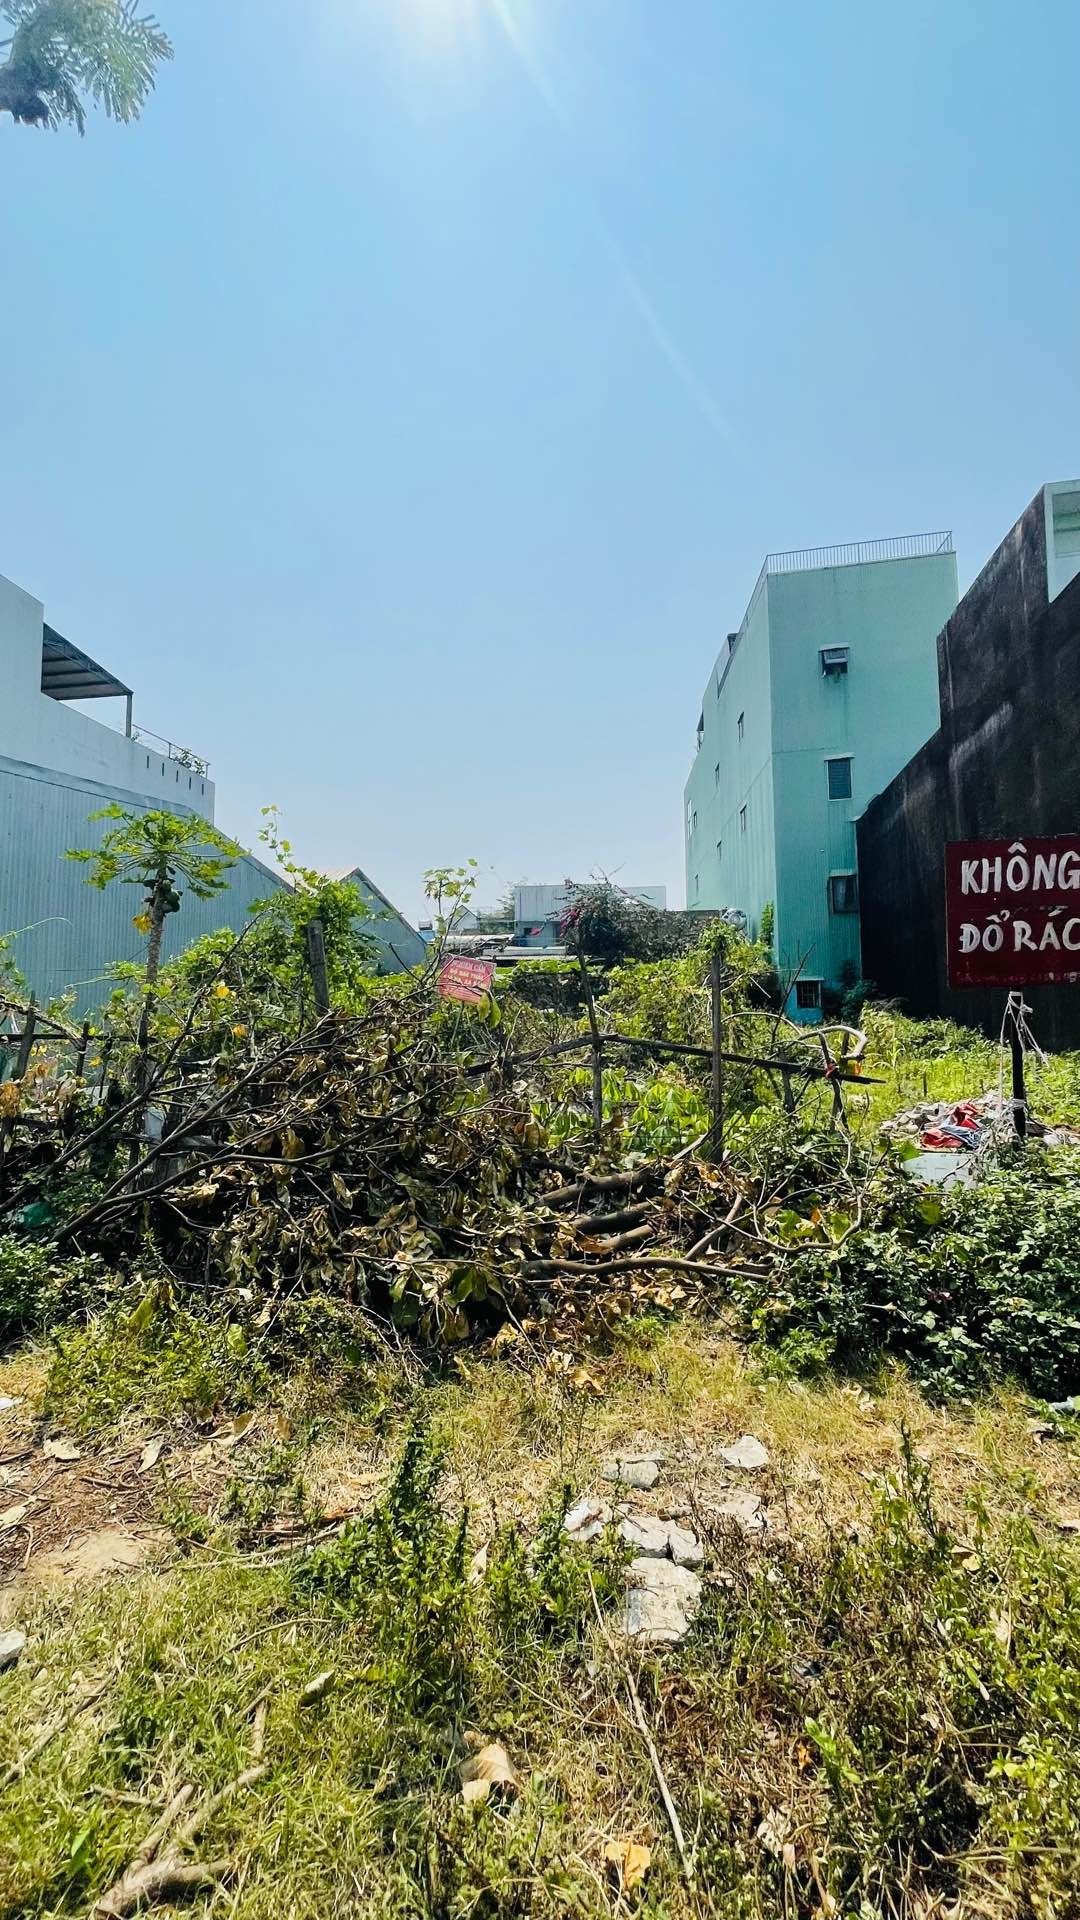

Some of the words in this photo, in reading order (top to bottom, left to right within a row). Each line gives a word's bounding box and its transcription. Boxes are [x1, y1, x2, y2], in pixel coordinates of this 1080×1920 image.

[961, 841, 1080, 895] KHÔNG
[958, 909, 1011, 953] ĐỔ
[1012, 907, 1080, 952] RÁC
